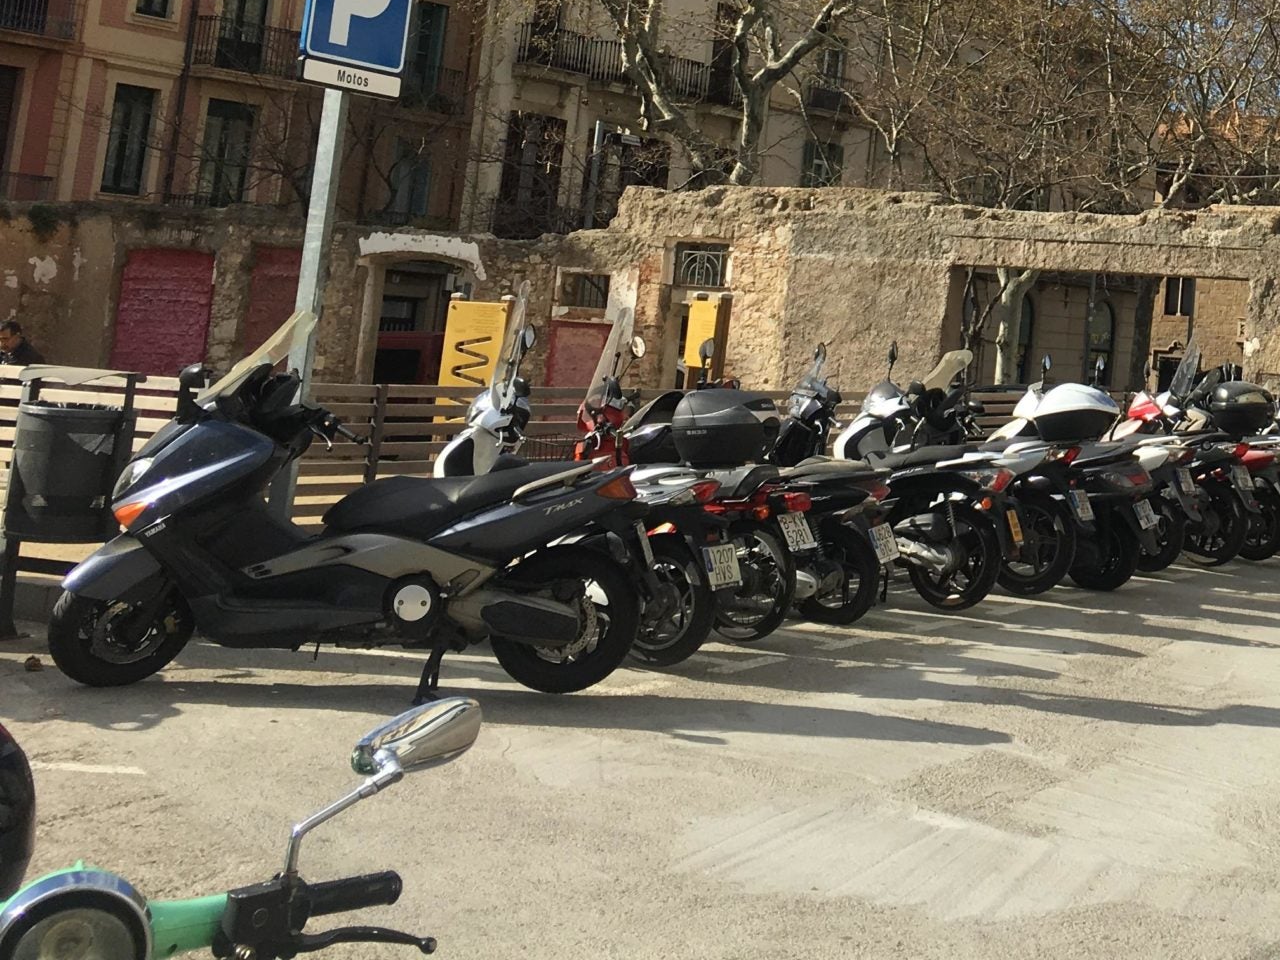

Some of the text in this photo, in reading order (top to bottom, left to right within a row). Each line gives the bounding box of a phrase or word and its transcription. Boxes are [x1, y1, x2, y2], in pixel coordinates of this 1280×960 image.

[336, 69, 369, 87] Motos
[712, 547, 733, 565] 1207
[714, 564, 734, 583] HVS
